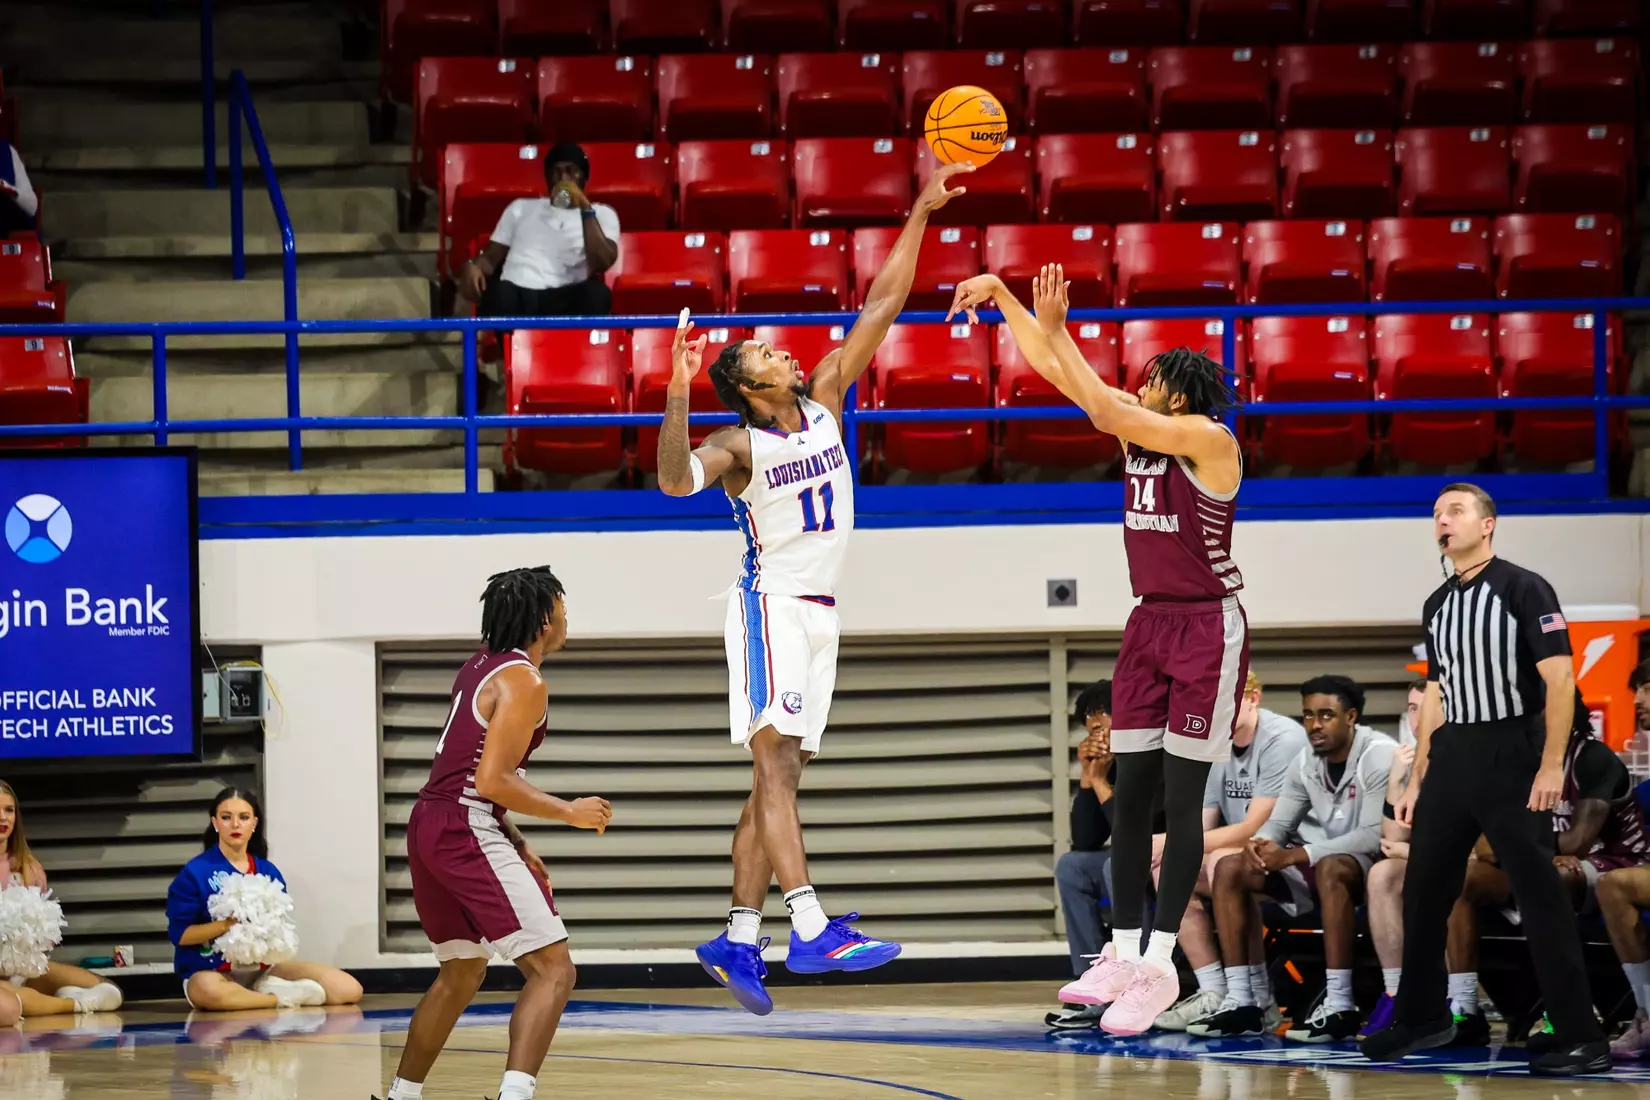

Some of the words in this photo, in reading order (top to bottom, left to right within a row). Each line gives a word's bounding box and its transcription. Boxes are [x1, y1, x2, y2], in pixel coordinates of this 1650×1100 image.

[765, 453, 827, 489] LOUISIANA
[797, 480, 835, 532] 11
[65, 584, 170, 626] Bank
[108, 626, 146, 637] Member
[147, 625, 170, 636] FDIC
[0, 689, 86, 711] FFICIAL
[92, 687, 157, 708] BANK
[0, 717, 48, 739] ECH
[55, 714, 174, 738] ATHLETICS
